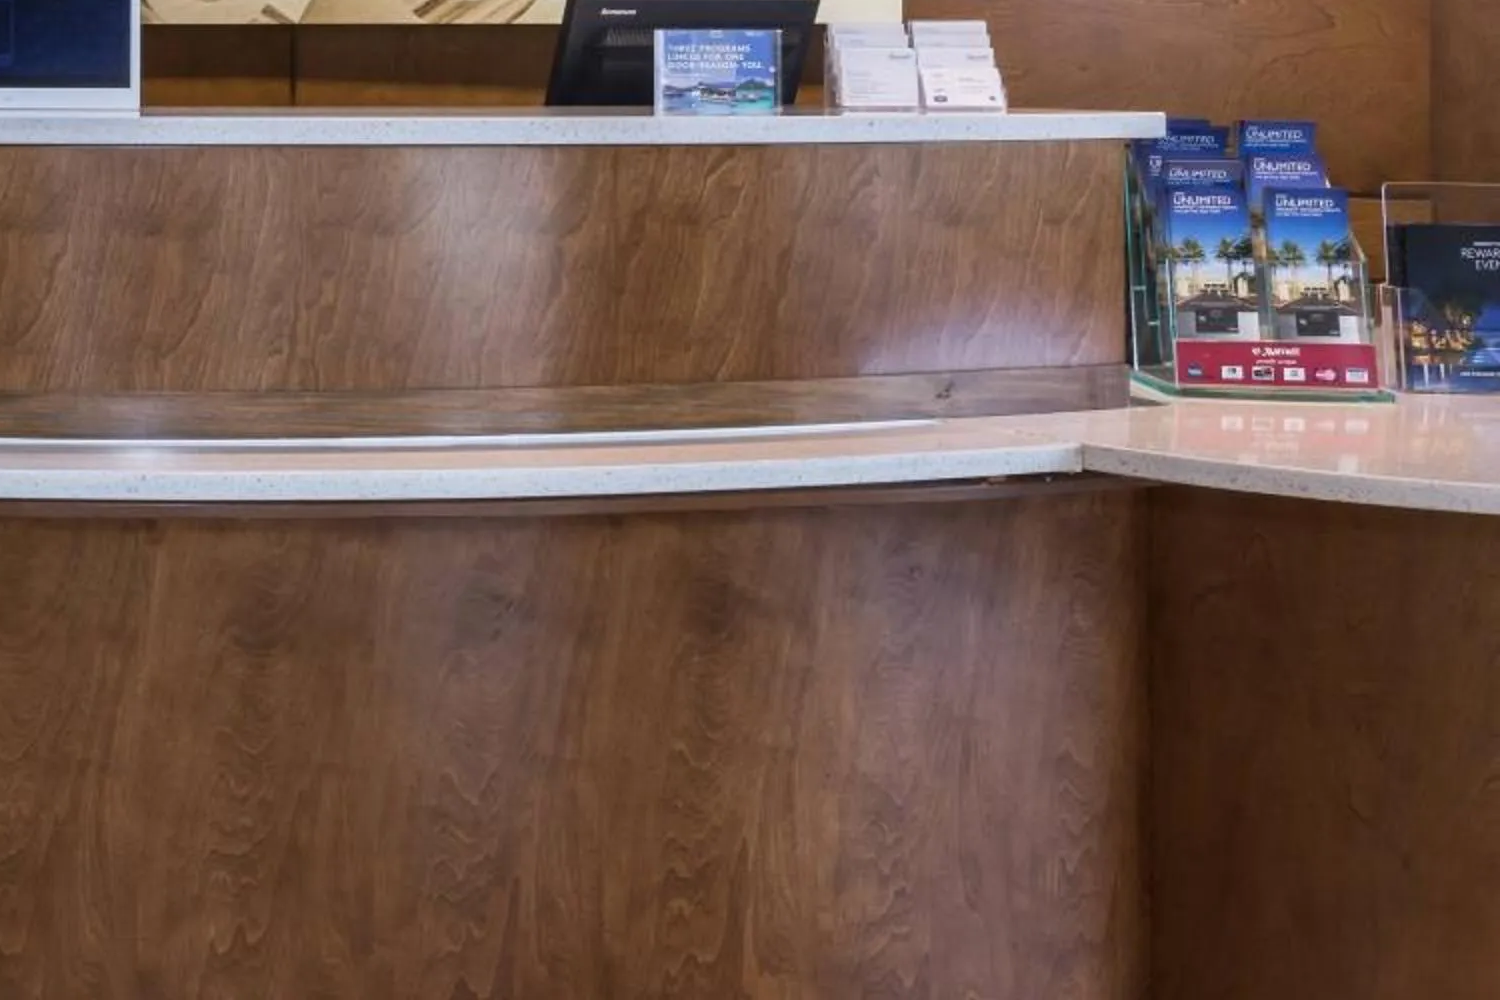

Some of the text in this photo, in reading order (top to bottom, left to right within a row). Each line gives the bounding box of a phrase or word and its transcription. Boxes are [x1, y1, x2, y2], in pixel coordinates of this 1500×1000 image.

[1253, 160, 1311, 171] UNLIMITED
[1173, 194, 1231, 205] UNLIMITED
[1275, 197, 1334, 208] UNLIMITED
